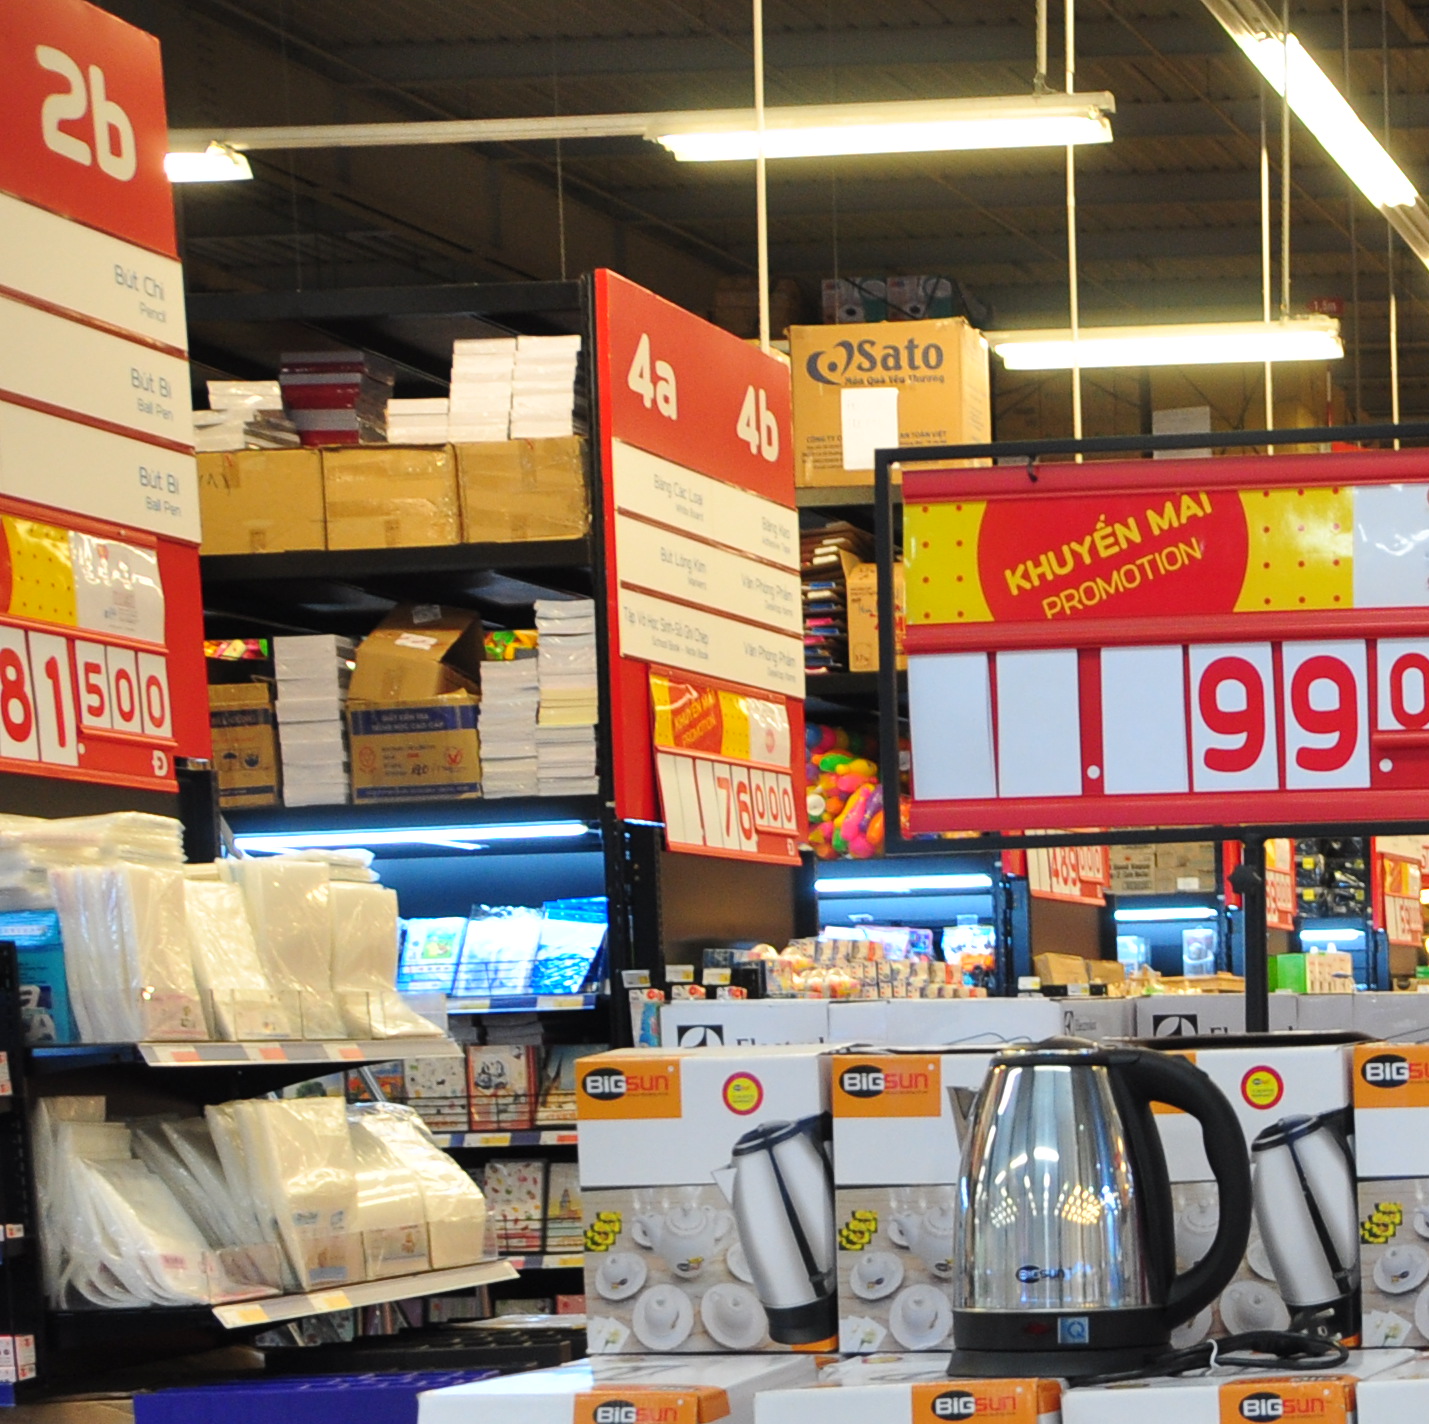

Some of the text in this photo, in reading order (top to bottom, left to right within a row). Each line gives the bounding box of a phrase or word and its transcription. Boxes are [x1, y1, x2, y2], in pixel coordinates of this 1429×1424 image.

[36, 44, 138, 182] 2b
[856, 338, 944, 372] Sato
[628, 333, 780, 463] 4a 4b
[1004, 513, 1142, 596] KHUYẾN
[1041, 536, 1203, 620] PROMOTION
